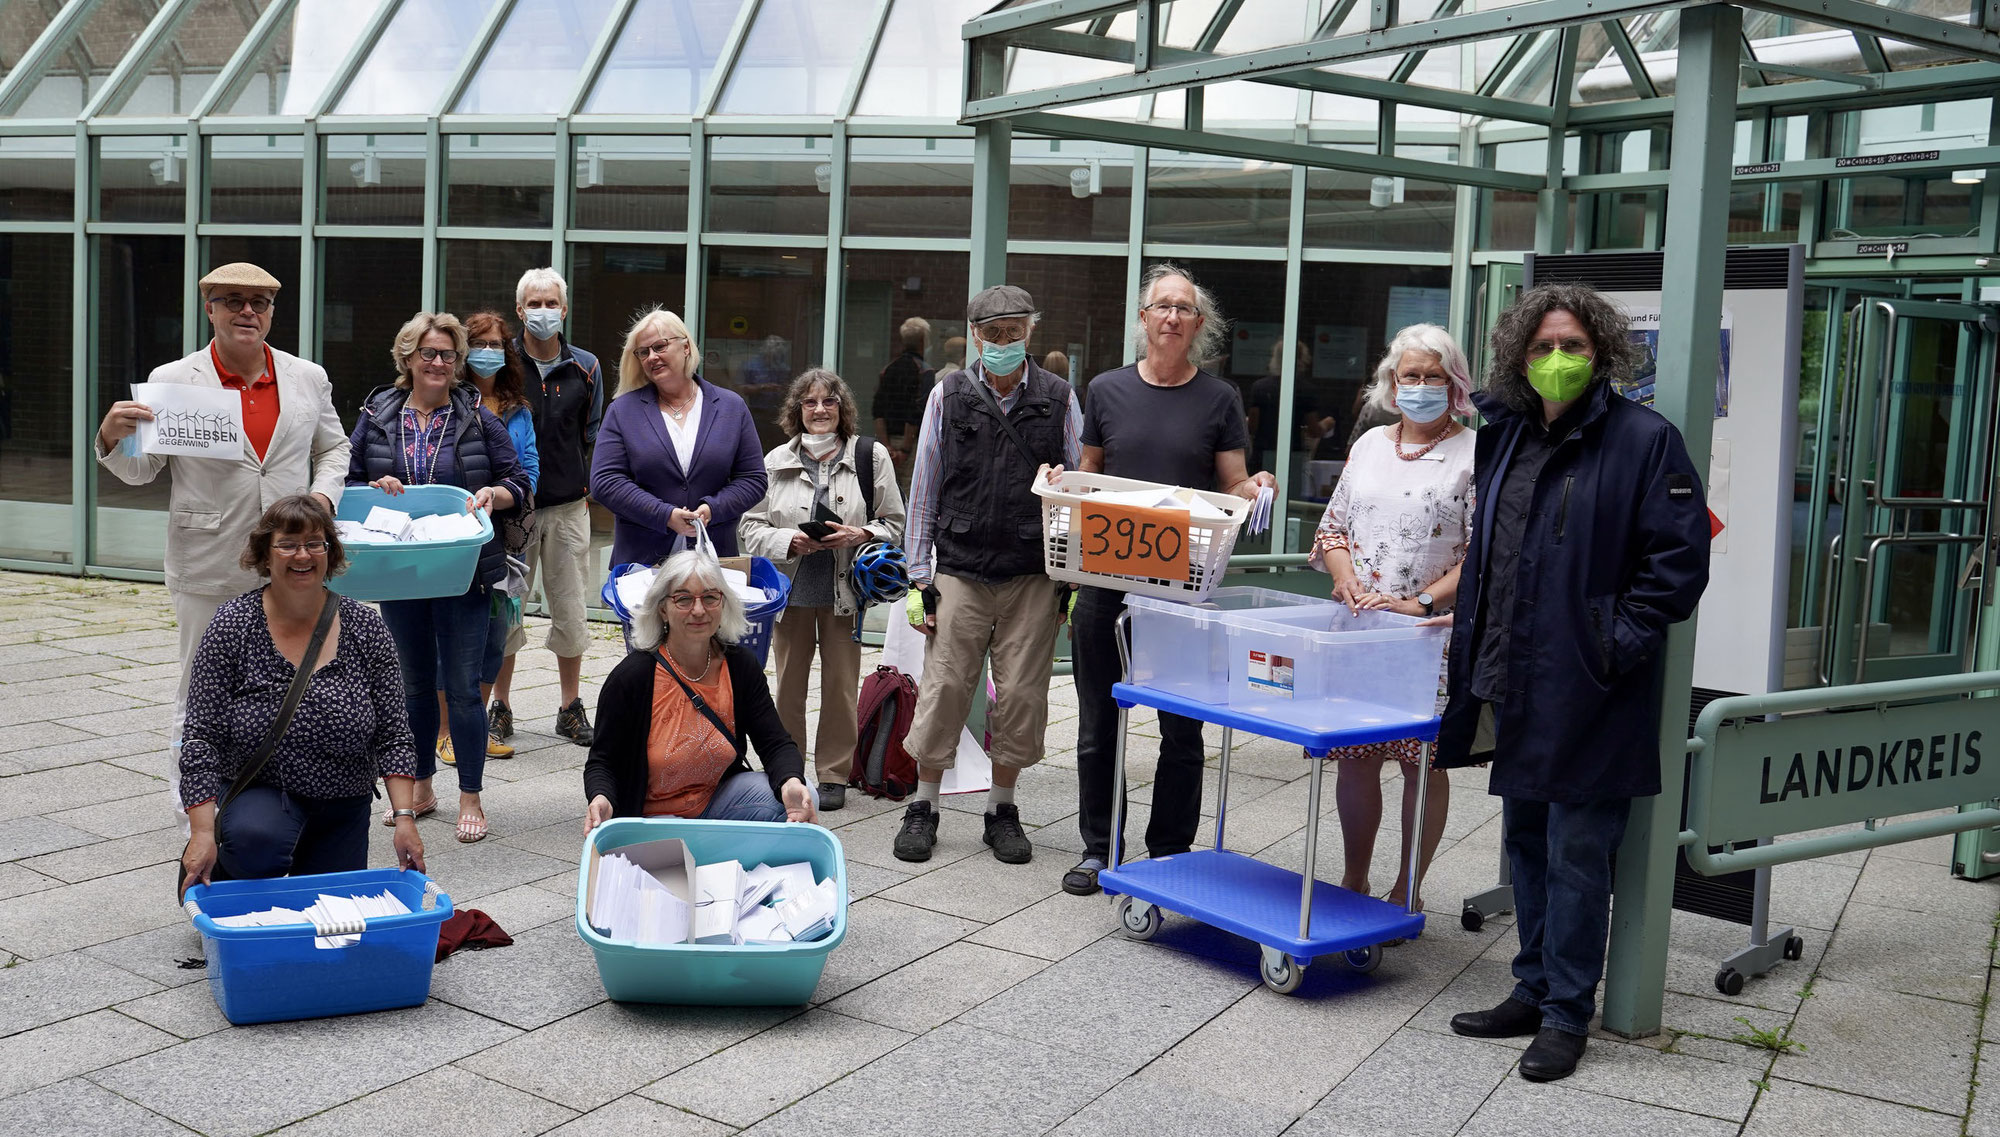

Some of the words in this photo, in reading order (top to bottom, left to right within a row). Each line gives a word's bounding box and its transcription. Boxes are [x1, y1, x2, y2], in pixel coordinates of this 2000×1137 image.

[1631, 314, 1647, 322] und
[158, 438, 210, 449] GEGENWIND
[1086, 514, 1182, 562] 3950
[1759, 730, 1983, 804] LANDKREIS
